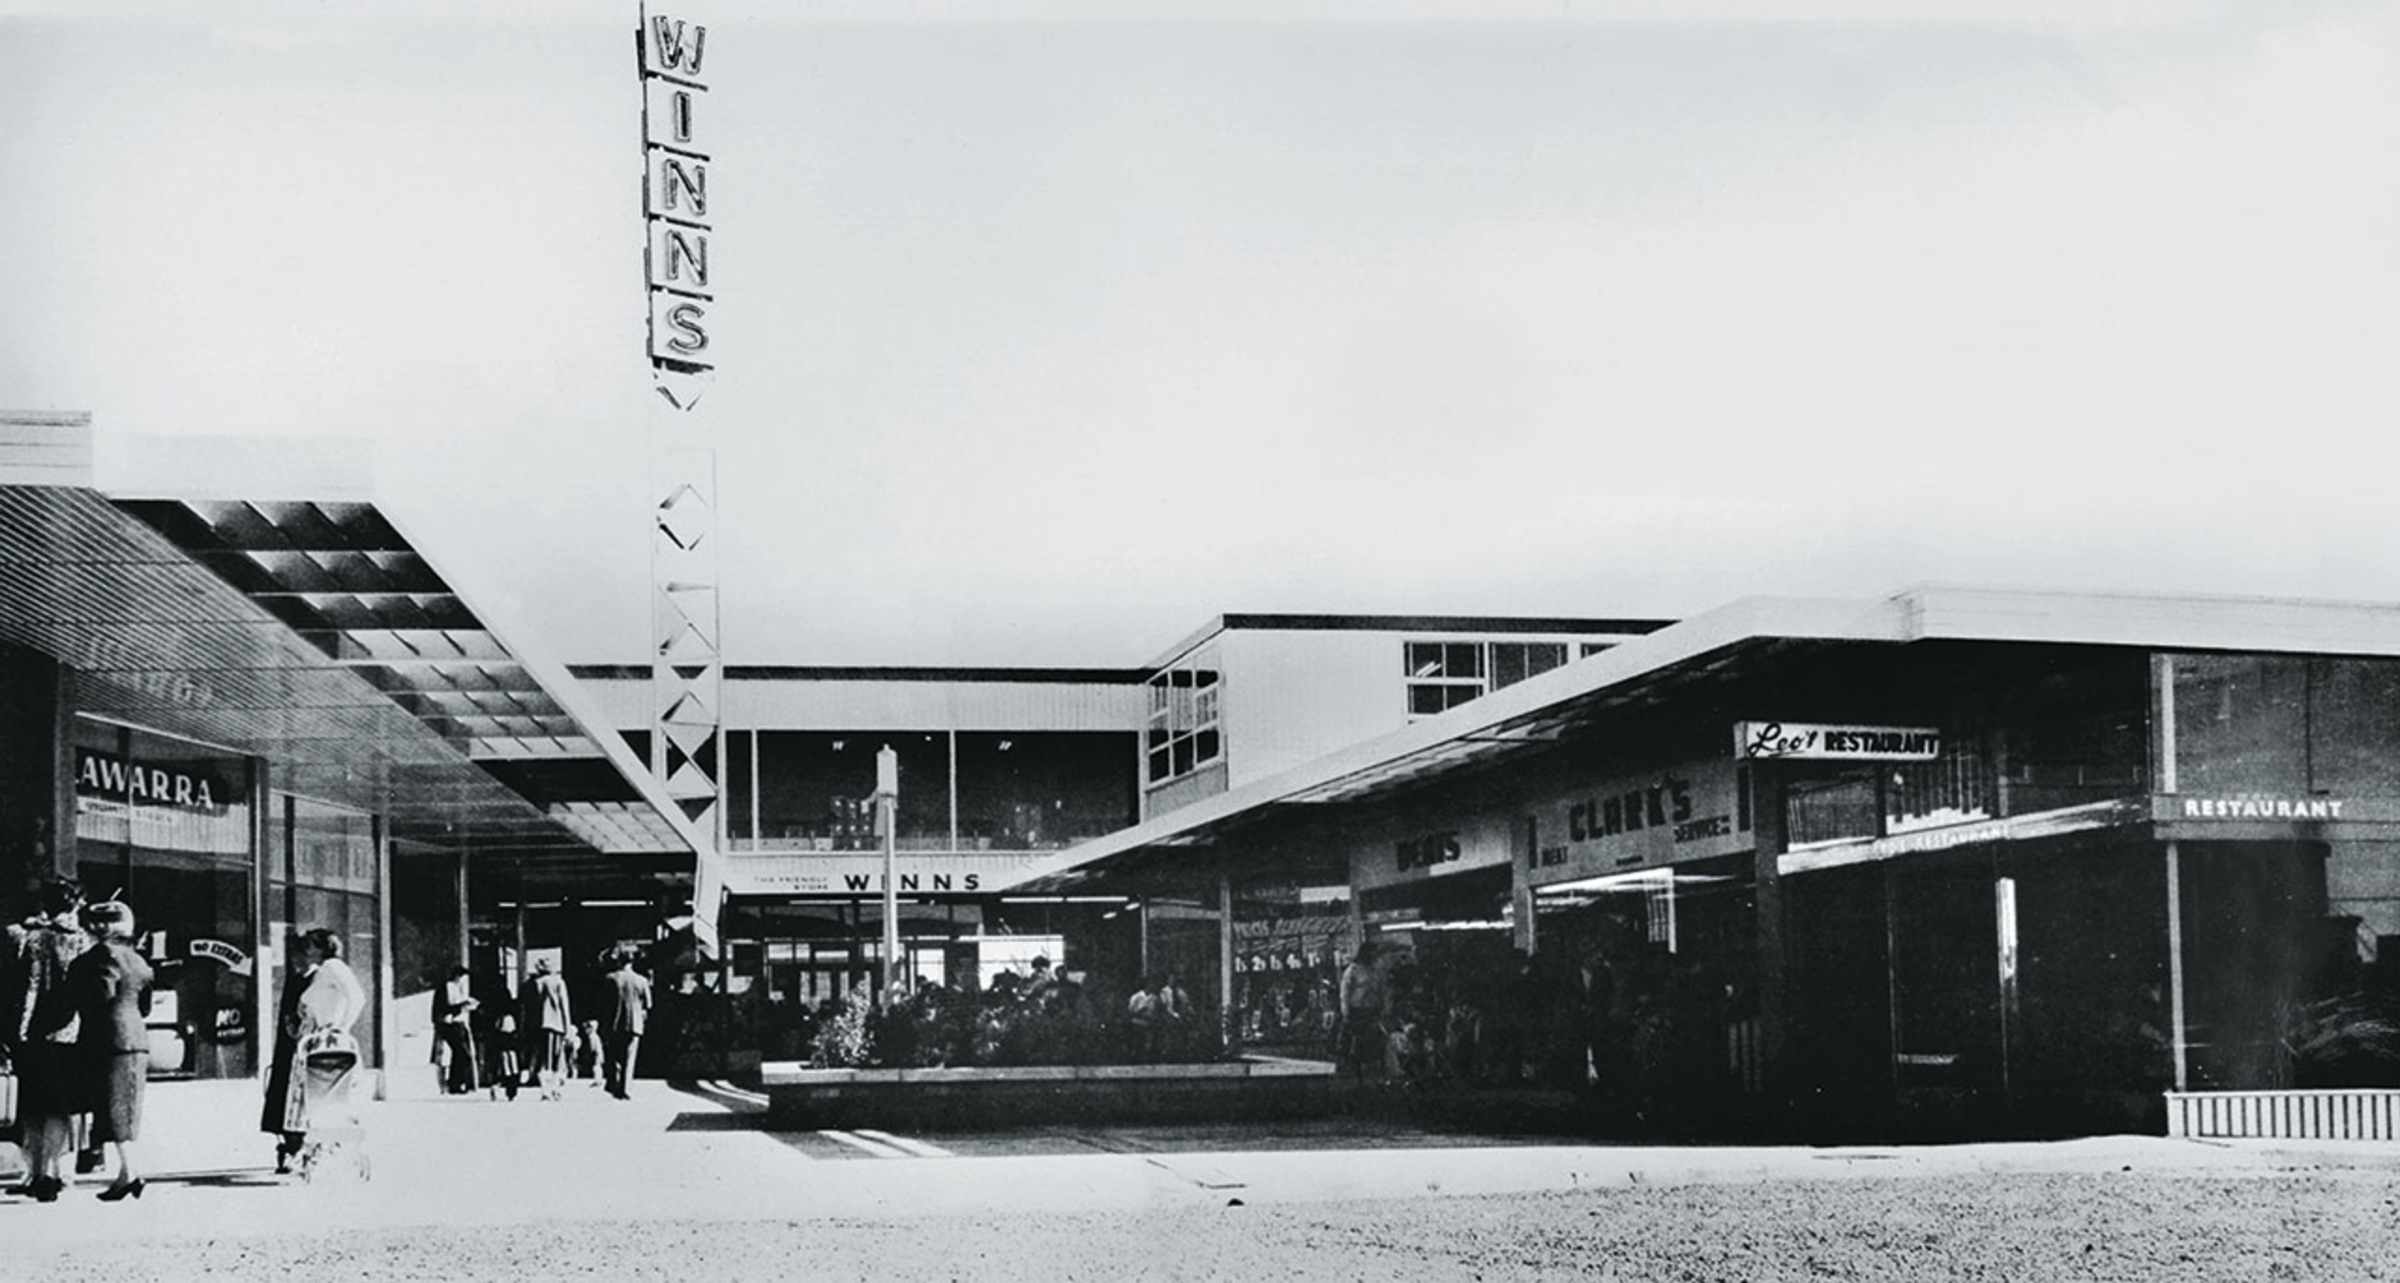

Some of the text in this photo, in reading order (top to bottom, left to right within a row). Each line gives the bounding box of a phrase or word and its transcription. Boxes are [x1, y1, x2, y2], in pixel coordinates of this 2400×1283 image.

[651, 14, 709, 356] WINNS
[1823, 730, 1938, 753] RESTAURANT
[75, 756, 214, 810] AWARRA
[2185, 799, 2342, 817] RESTAURANT
[844, 873, 980, 891] WINNS
